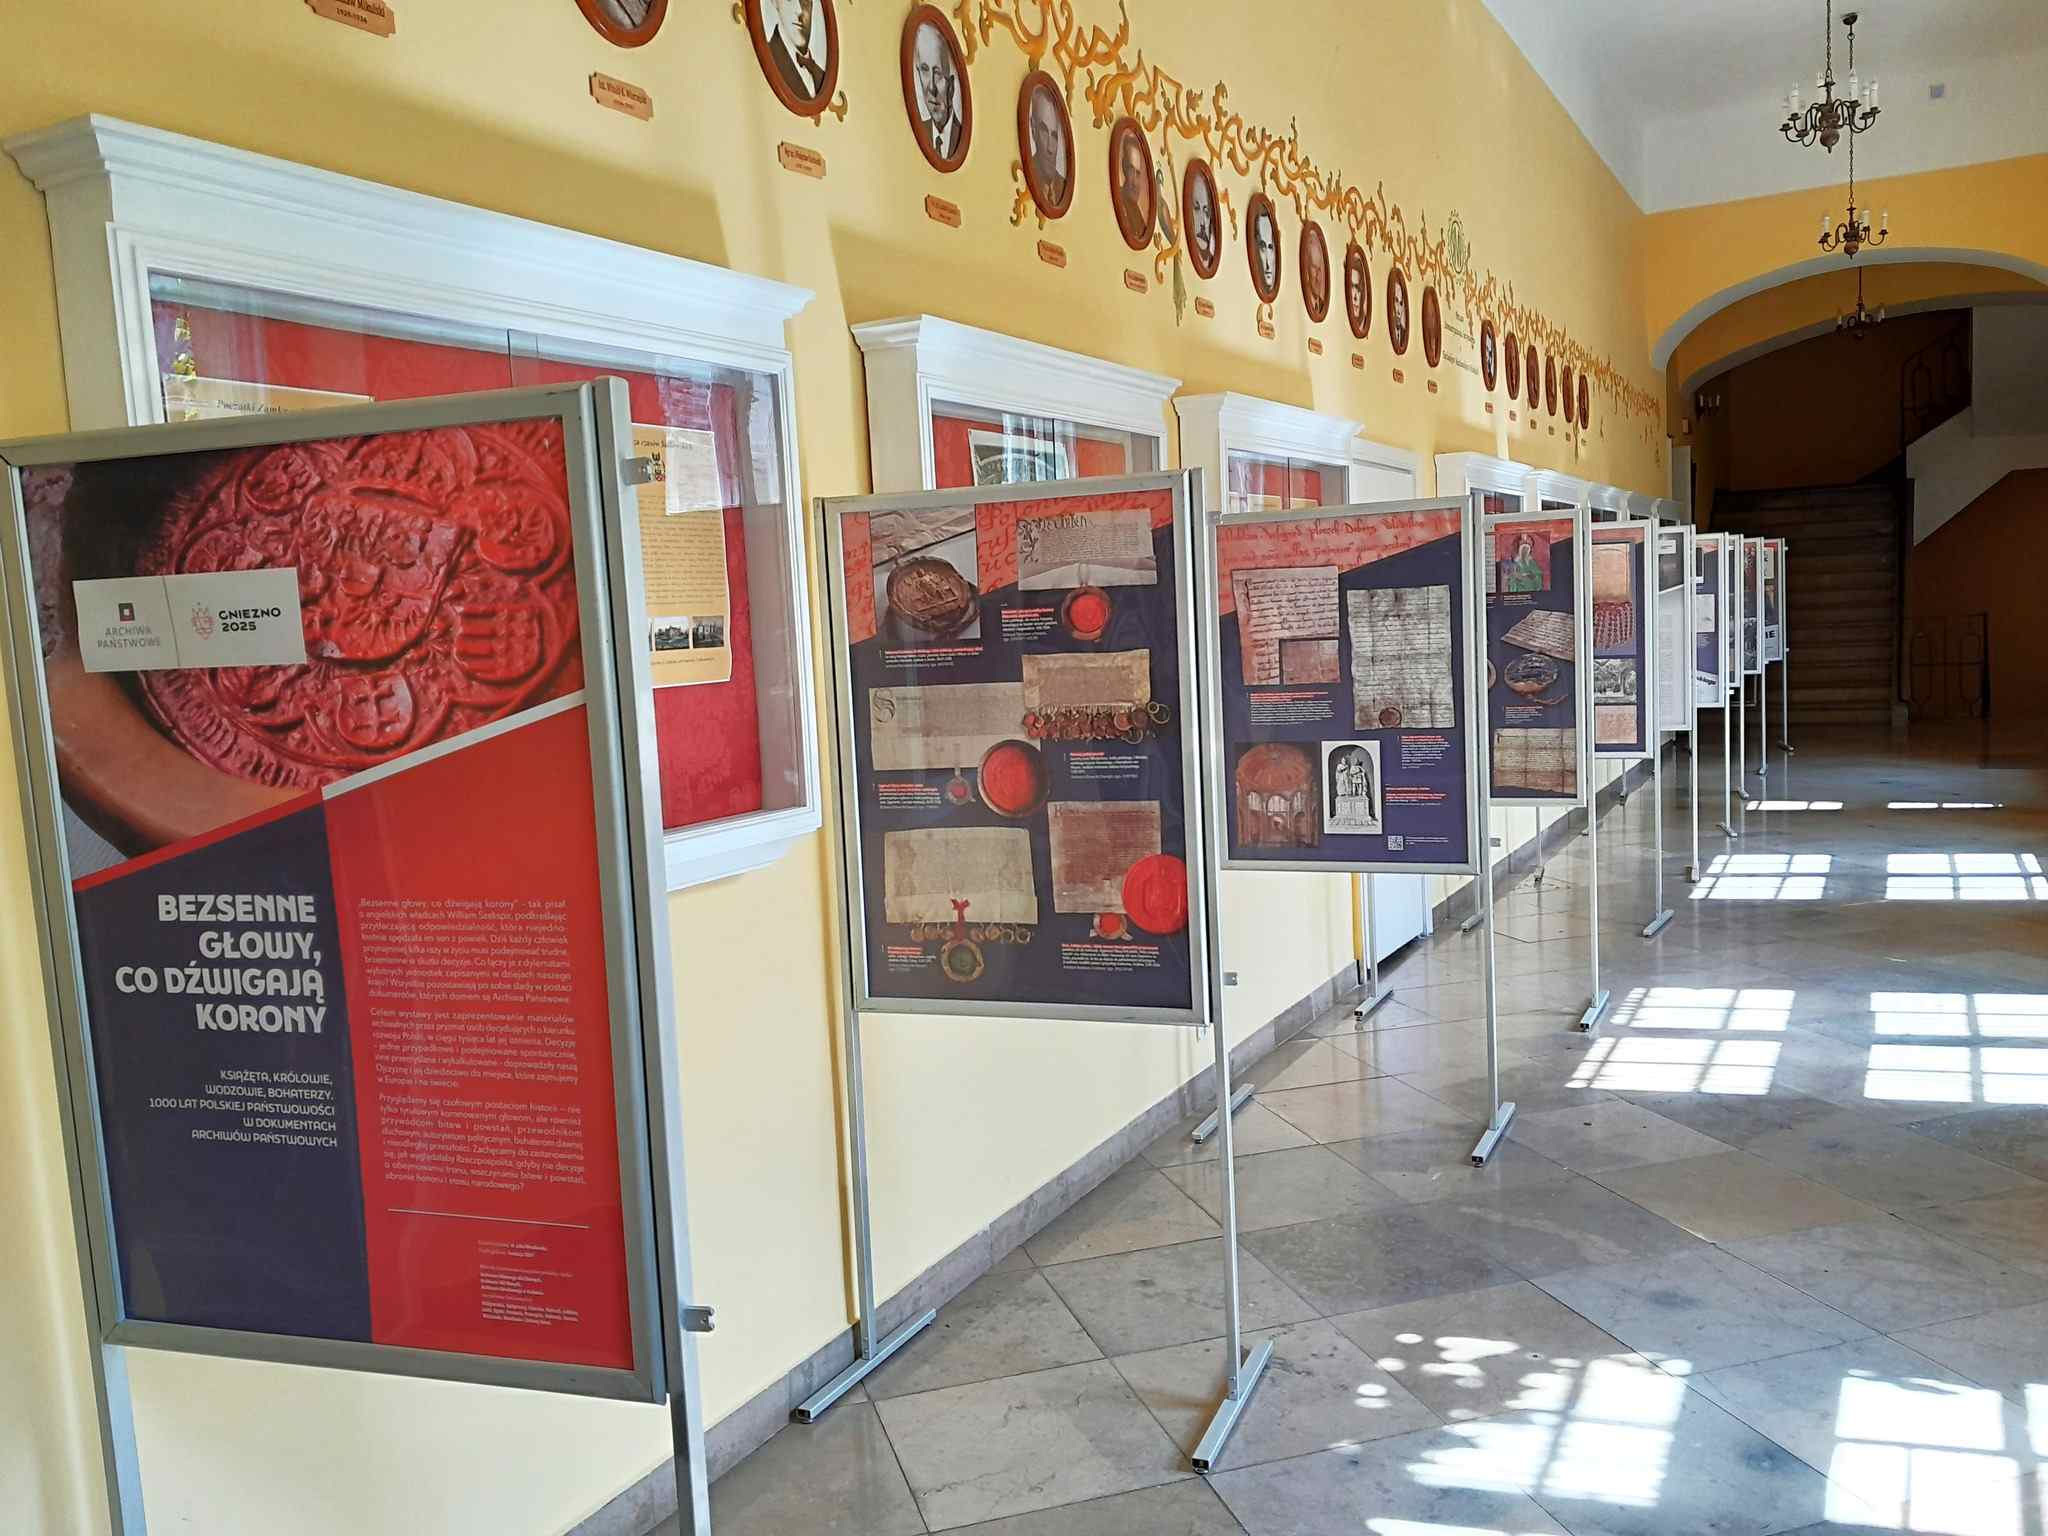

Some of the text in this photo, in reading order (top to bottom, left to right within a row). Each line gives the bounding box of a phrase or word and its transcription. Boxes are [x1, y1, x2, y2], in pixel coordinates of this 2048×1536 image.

[218, 607, 282, 620] GNIEZNO
[104, 626, 153, 637] ARCHIWA
[222, 621, 257, 633] 2025
[157, 894, 317, 923] BEZSENNE
[198, 931, 322, 967] GŁOWY,
[115, 960, 325, 1004] CO DŹWIGAJĄ
[195, 1003, 326, 1033] KORONY
[220, 1067, 333, 1085] KSIĄŻĘTA, KRÓLOWIE,
[204, 1084, 335, 1101] WODZOWIE, BOHATERZY.
[149, 1097, 335, 1116] 1000 LAT POLSKIEJ PAŃSTWOWOŚCI
[242, 1117, 336, 1132] W DOKUMENTACH
[191, 1129, 337, 1147] ARCHIWÓW PAŃSTWOWYCH
